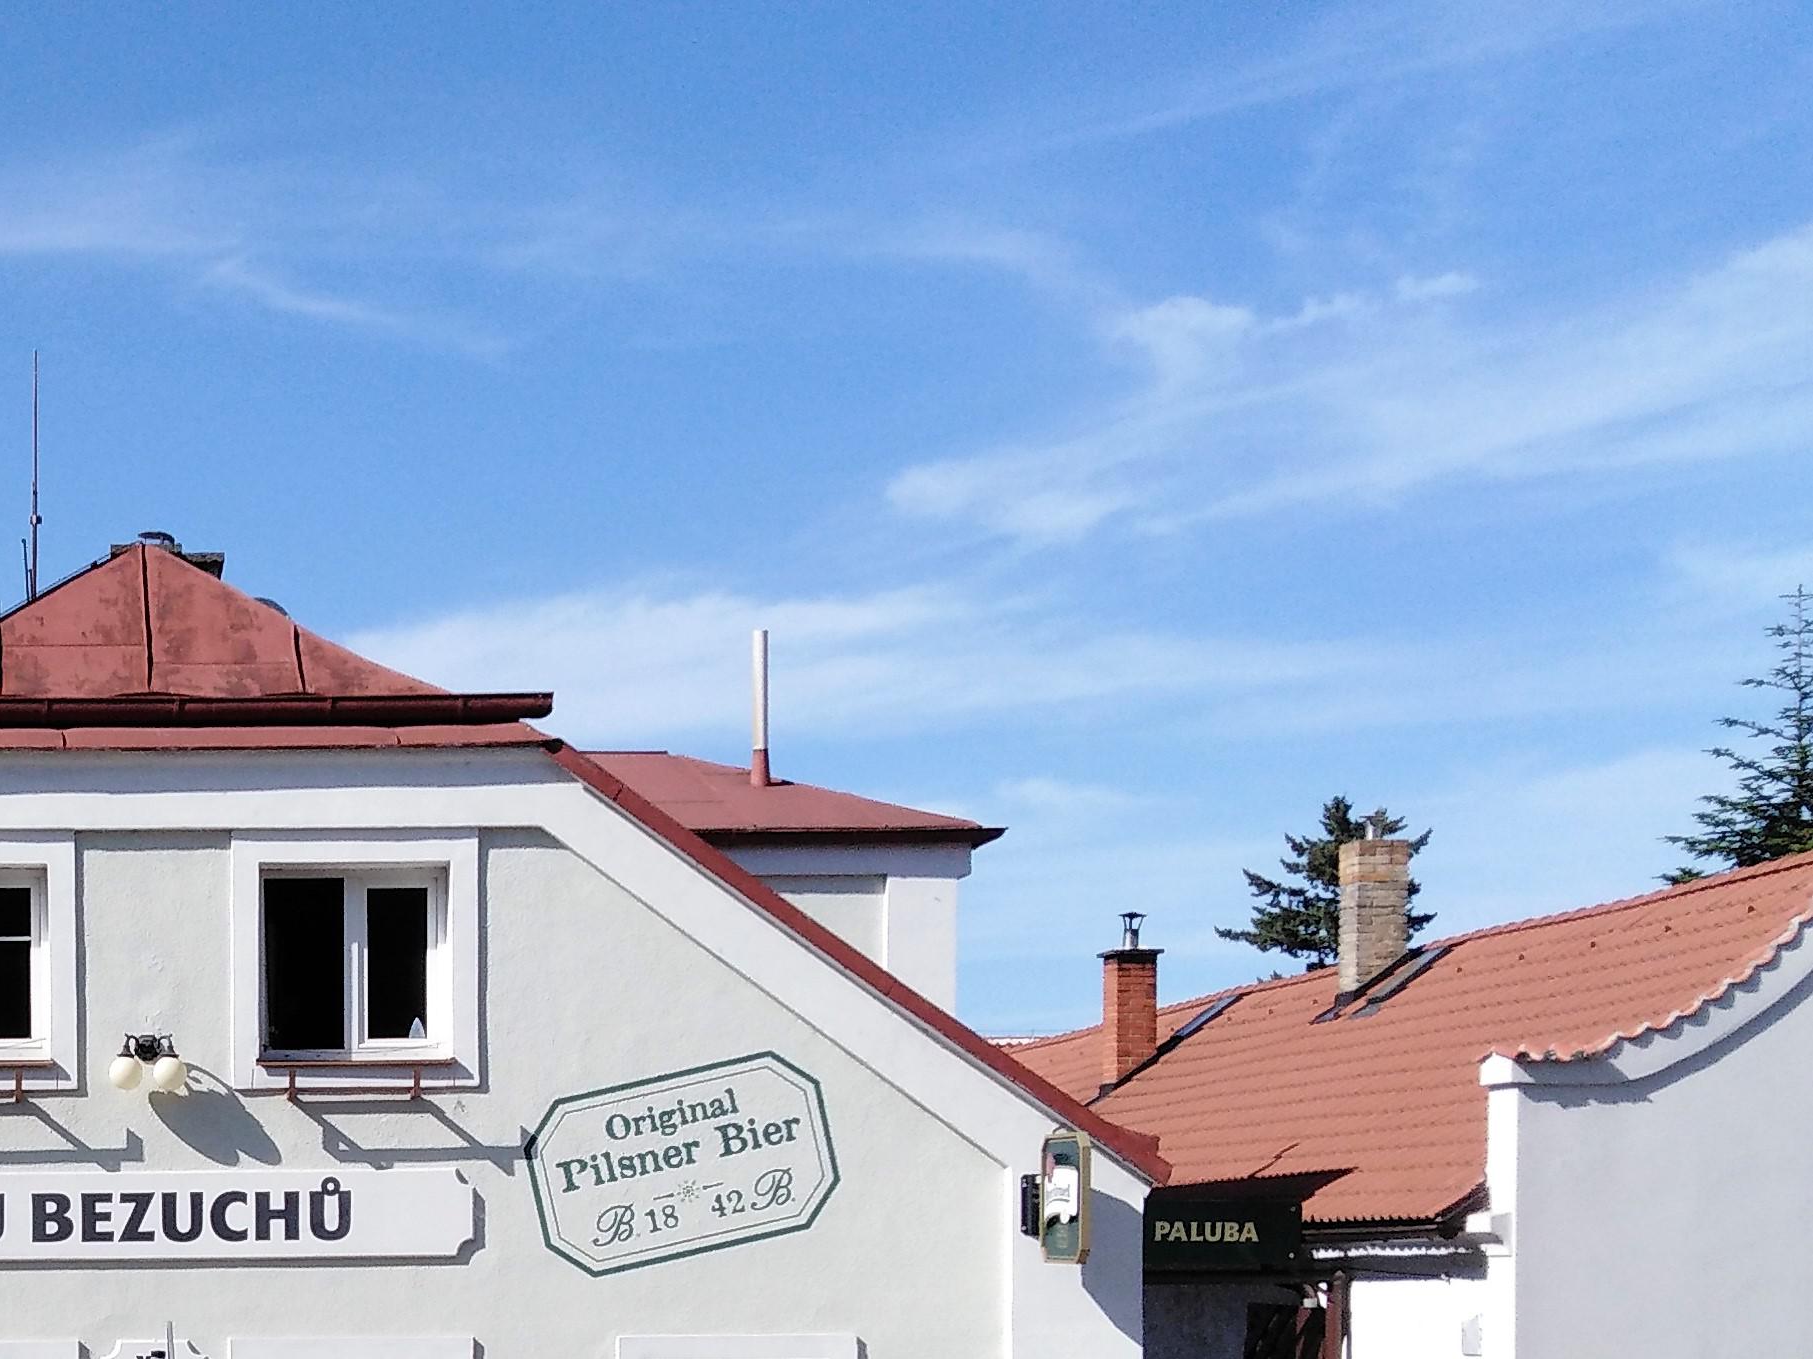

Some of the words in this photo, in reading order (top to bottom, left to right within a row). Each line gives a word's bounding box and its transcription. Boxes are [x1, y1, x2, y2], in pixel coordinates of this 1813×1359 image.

[605, 1088, 740, 1141] Original
[556, 1140, 701, 1193] Pilsner
[714, 1116, 801, 1158] Bier
[31, 1176, 352, 1243] BEZUCHŮ
[644, 1204, 679, 1234] 18
[711, 1190, 746, 1218] 42
[1153, 1220, 1260, 1243] PALUBA
